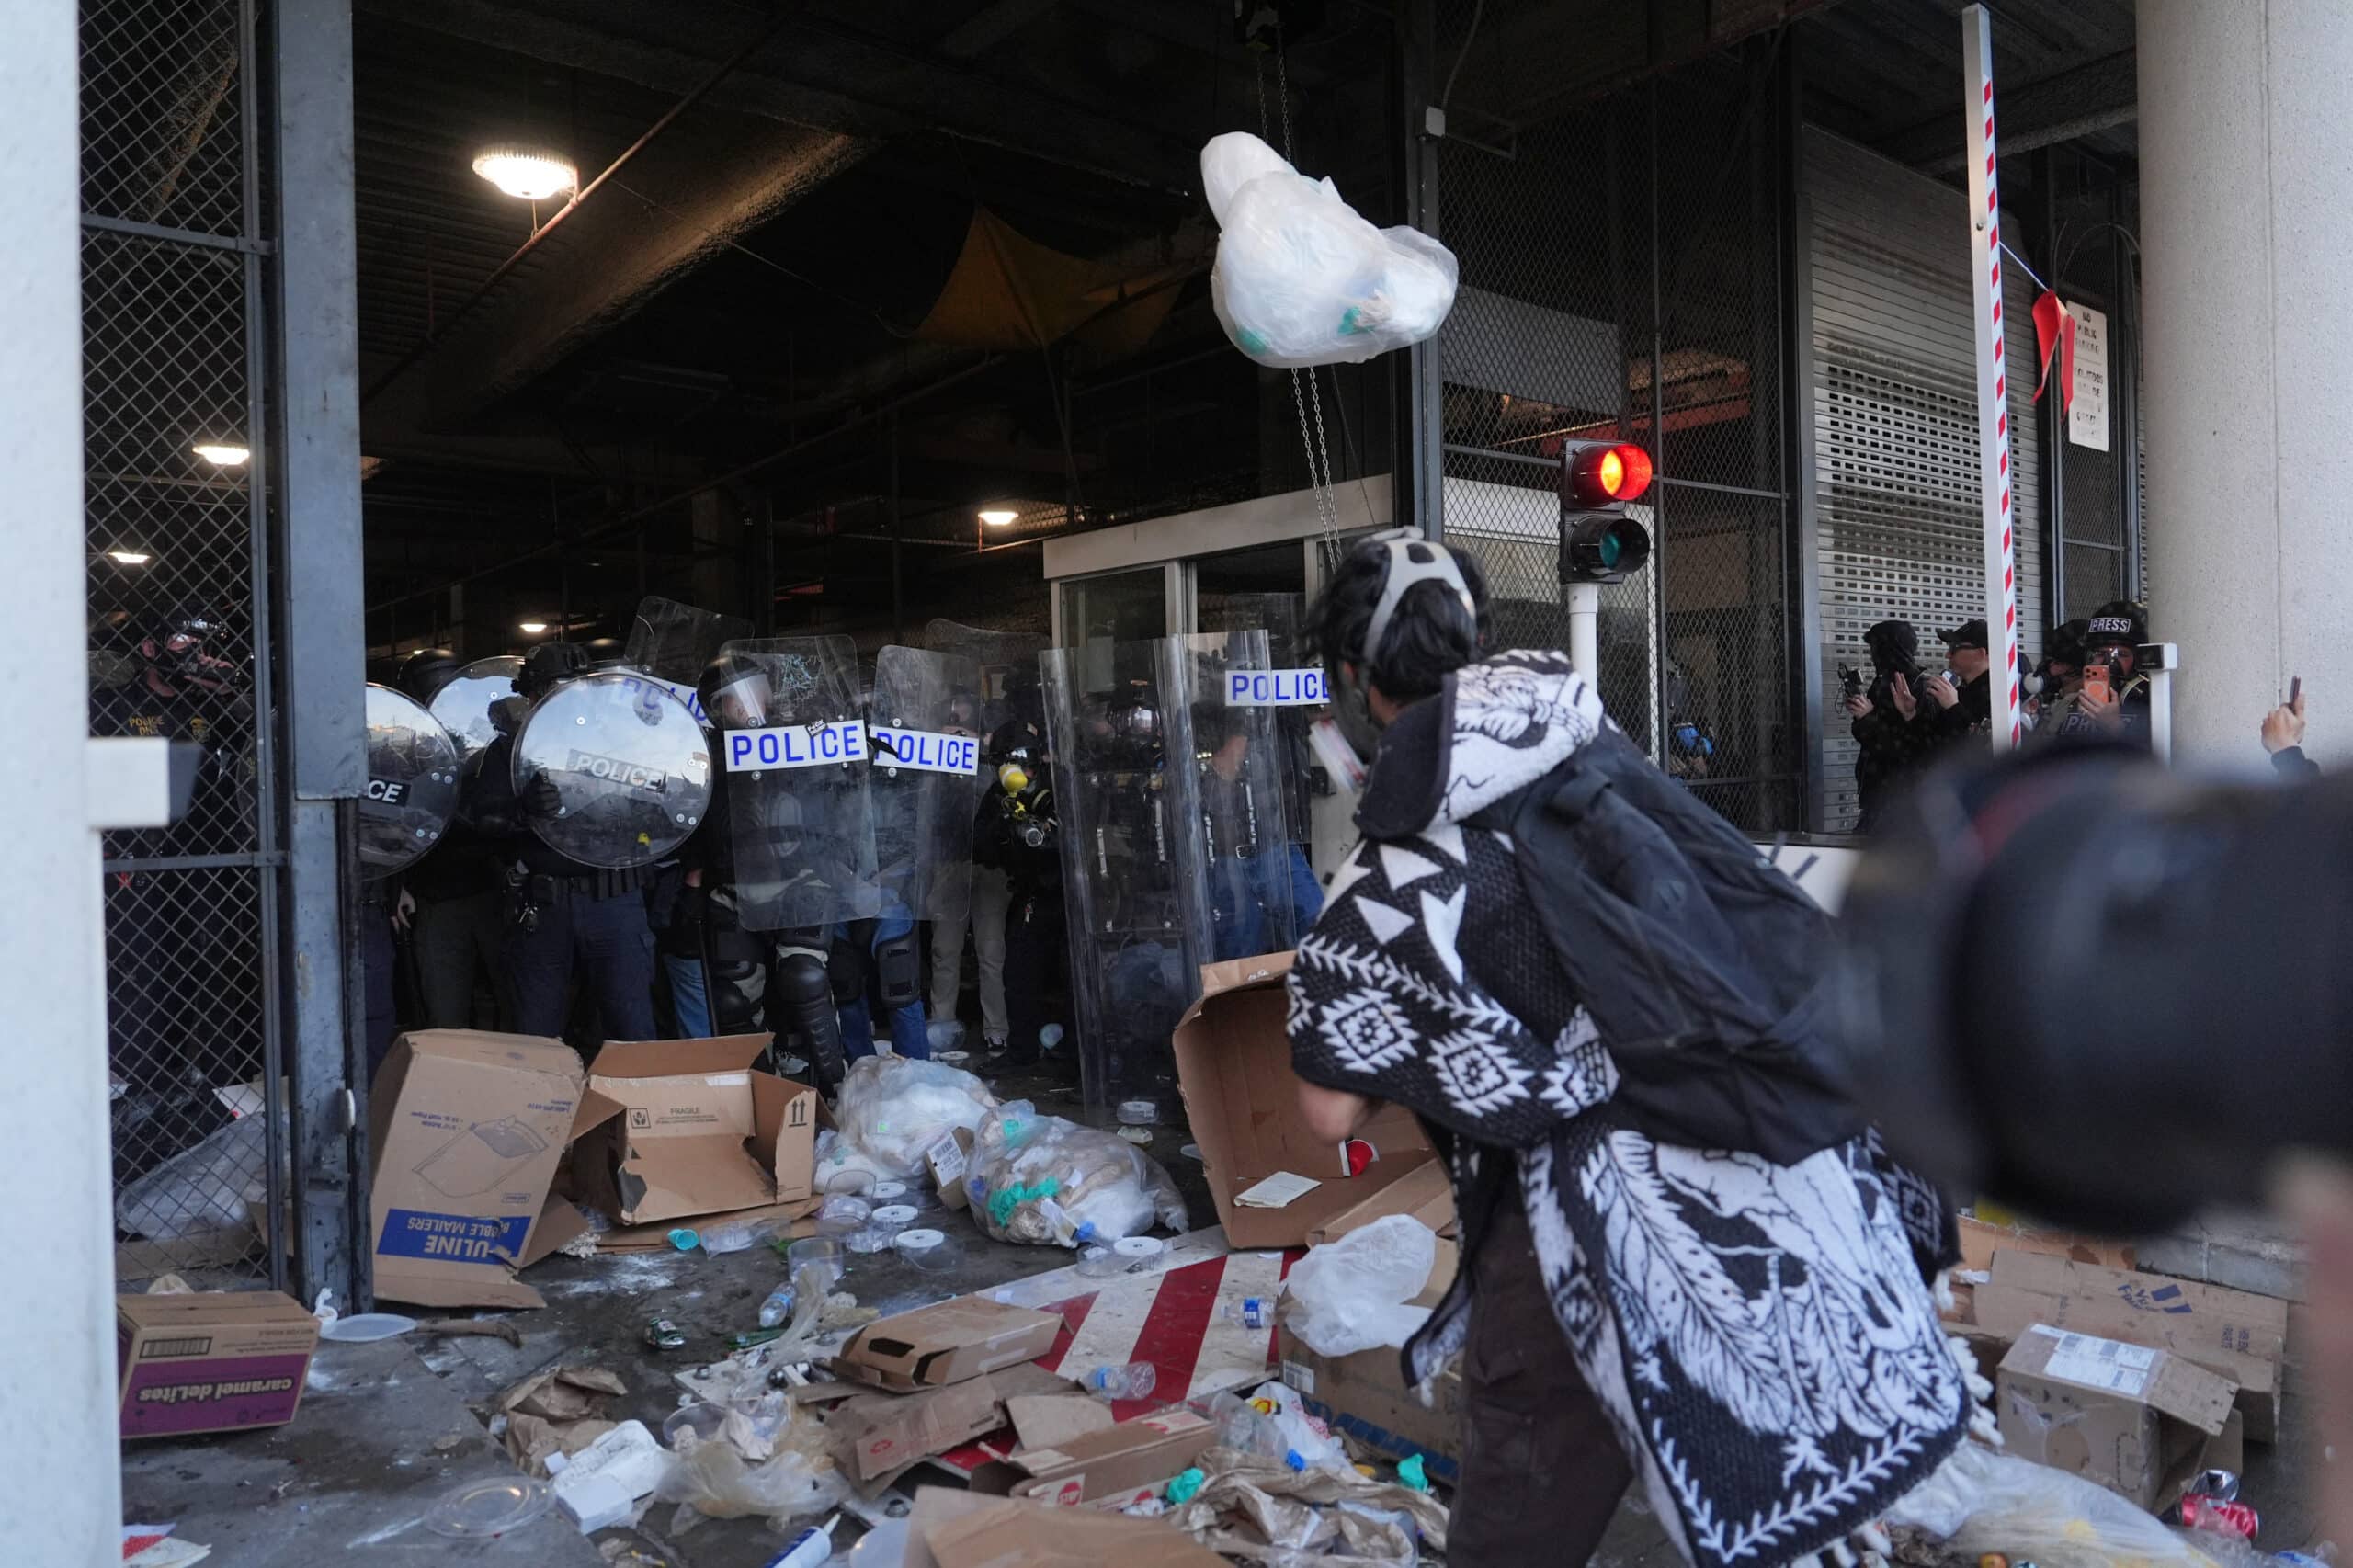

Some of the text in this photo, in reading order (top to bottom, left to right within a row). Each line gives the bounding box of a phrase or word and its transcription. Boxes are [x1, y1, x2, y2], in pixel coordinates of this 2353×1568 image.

[2091, 619, 2129, 631] PRESS
[732, 725, 861, 766] POLICE
[875, 732, 975, 769] POLICE
[574, 754, 667, 791] POLICE
[407, 1217, 467, 1234] MAILERS
[424, 1234, 490, 1258] ULINE
[139, 1378, 293, 1403] caramel deLites
